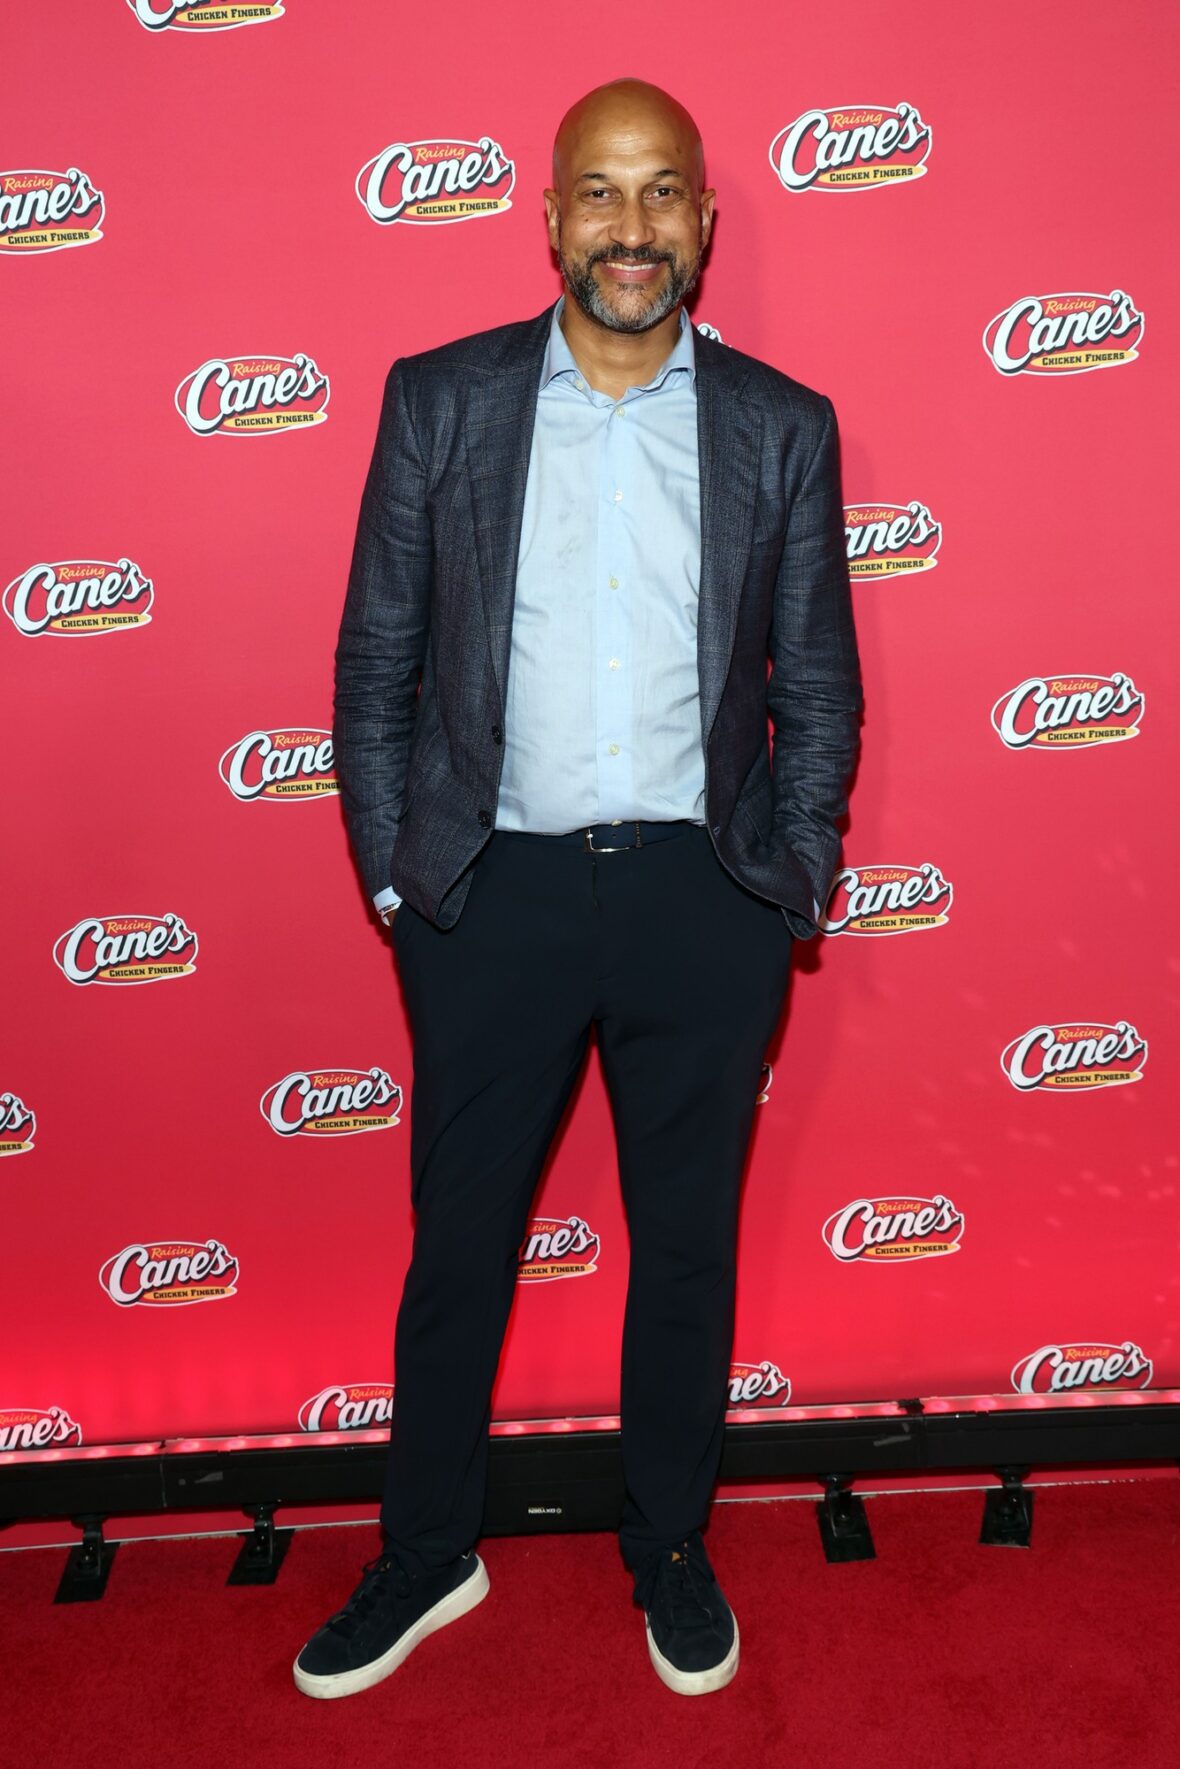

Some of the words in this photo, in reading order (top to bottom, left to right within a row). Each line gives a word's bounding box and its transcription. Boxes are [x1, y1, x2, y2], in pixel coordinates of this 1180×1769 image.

[187, 9, 227, 21] CHICKEN
[230, 7, 271, 19] FINGERS
[832, 113, 883, 129] Raising
[780, 105, 928, 186] Cane's
[416, 148, 466, 162] Raising
[367, 140, 510, 219] Cane's
[830, 171, 870, 183] CHICKEN
[872, 168, 913, 180] FINGERS
[5, 177, 53, 192] Raising
[0, 170, 99, 229] ane's
[416, 203, 457, 215] CHICKEN
[459, 201, 499, 212] FINGERS
[7, 233, 47, 245] CHICKEN
[50, 231, 90, 242] FINGERS
[1046, 300, 1096, 315] Raising
[994, 293, 1140, 370] Cane's
[1042, 356, 1082, 367] CHICKEN
[1085, 352, 1125, 363] FINGERS
[233, 362, 280, 376] Raising
[186, 355, 326, 431] Cane's
[234, 417, 274, 427] CHICKEN
[276, 413, 314, 424] FINGERS
[847, 510, 894, 524] Raising
[886, 560, 924, 570] FINGERS
[60, 567, 105, 581] Raising
[14, 560, 150, 634] Cane's
[61, 618, 100, 628] CHICKEN
[102, 615, 139, 625] FINGERS
[1051, 681, 1098, 694] Raising
[1001, 675, 1141, 745] Cane's
[274, 734, 321, 748] Raising
[1047, 731, 1087, 741] CHICKEN
[1089, 729, 1127, 739] FINGERS
[230, 733, 334, 796] Cane
[275, 783, 313, 792] CHICKEN
[315, 780, 340, 790] FINGE
[862, 870, 908, 884] Raising
[826, 864, 951, 929] Cane's
[107, 922, 152, 934] Raising
[860, 919, 897, 928] CHICKEN
[899, 917, 936, 926] FINGERS
[64, 916, 196, 983] Cane's
[109, 969, 148, 978] CHICKEN
[150, 966, 184, 976] FINGERS
[1057, 1028, 1103, 1041] Raising
[1010, 1023, 1145, 1088] Cane's
[313, 1074, 358, 1087] Raising
[1055, 1075, 1091, 1084] CHICKEN
[1093, 1072, 1130, 1081] FINGERS
[271, 1068, 400, 1135] Cane's
[314, 1120, 350, 1129] CHICKEN
[353, 1117, 388, 1126] FINGERS
[0, 1143, 22, 1151] GERS
[876, 1202, 921, 1214] Raising
[533, 1222, 556, 1233] sing
[831, 1197, 963, 1259] Cane's
[528, 1217, 597, 1261] ne's
[152, 1247, 195, 1259] Raising
[875, 1246, 911, 1255] CHICKEN
[913, 1244, 948, 1252] FINGERS
[110, 1241, 236, 1303] Cane's
[551, 1264, 585, 1273] FINGERS
[153, 1291, 189, 1300] CHICKEN
[190, 1288, 225, 1297] FINGERS
[1064, 1347, 1109, 1360] Raising
[1017, 1343, 1148, 1392] Cane's
[307, 1387, 392, 1430] Can
